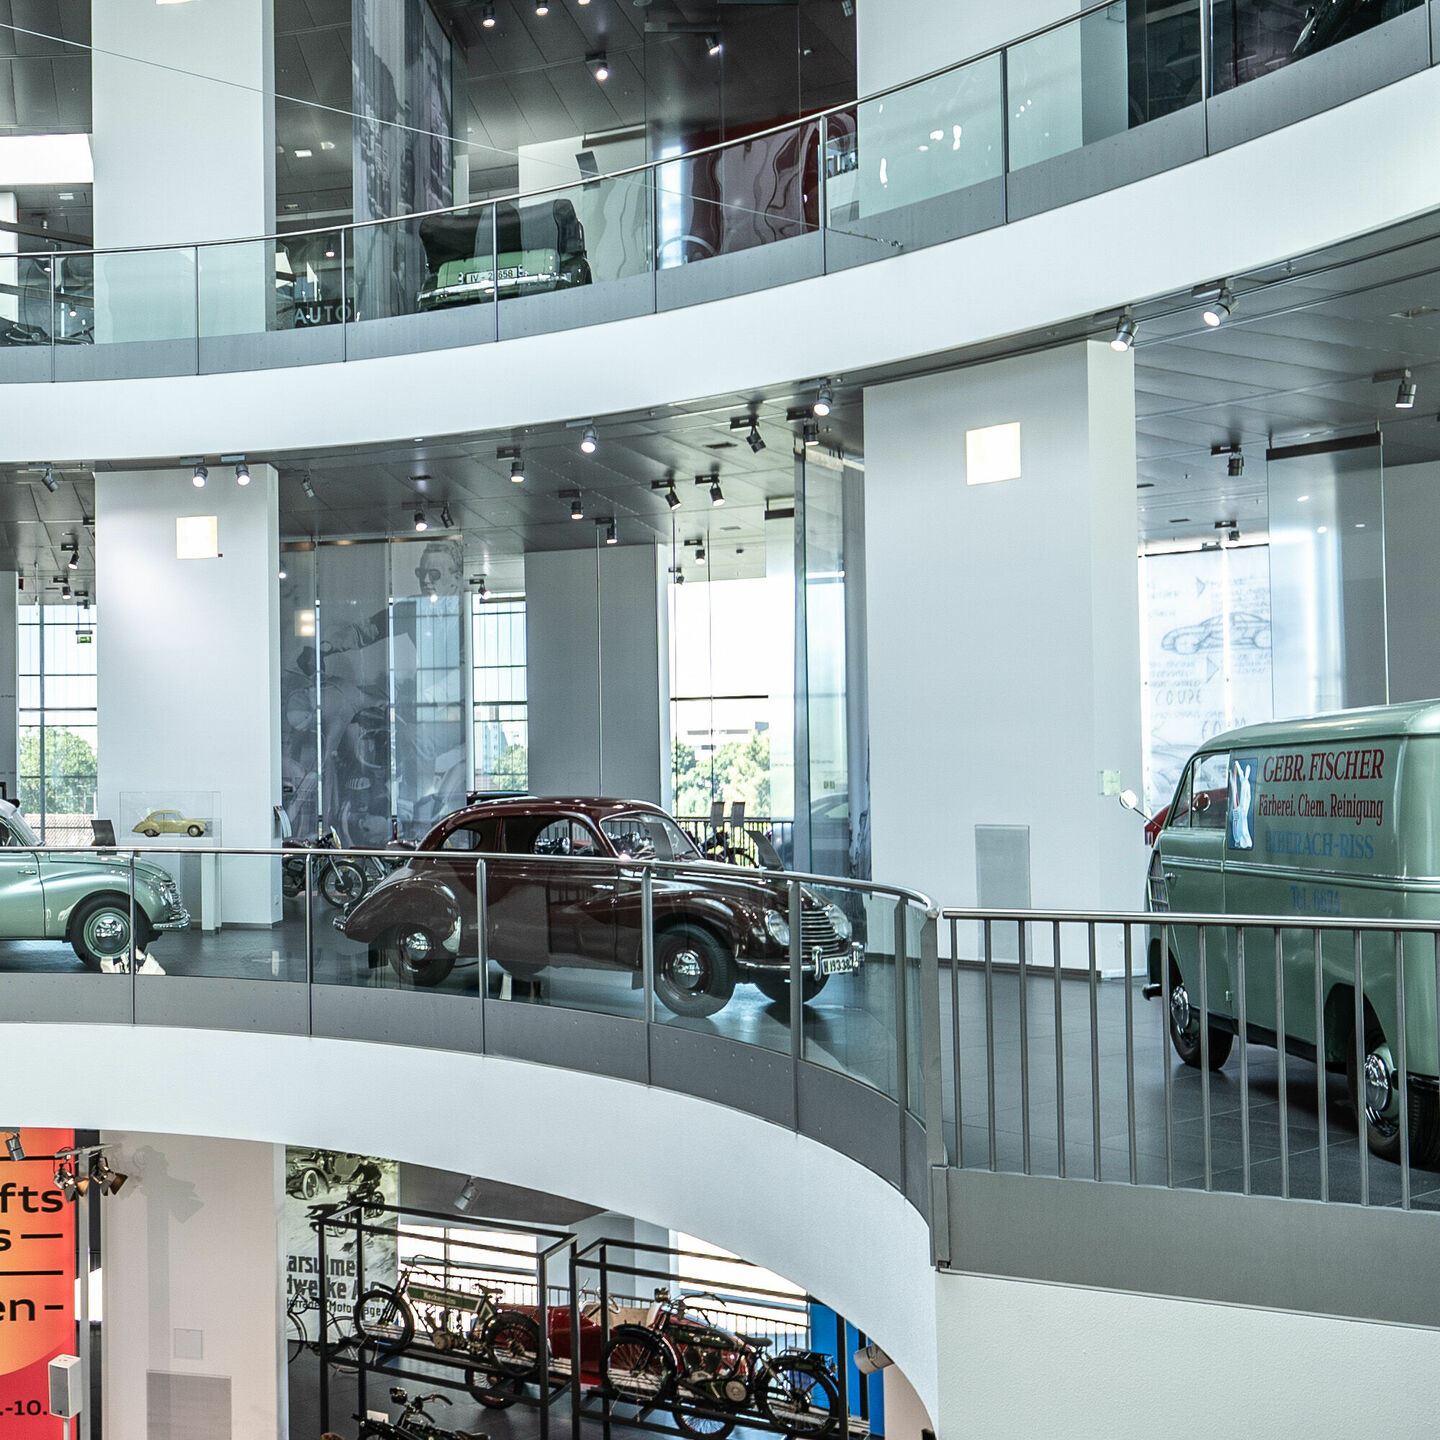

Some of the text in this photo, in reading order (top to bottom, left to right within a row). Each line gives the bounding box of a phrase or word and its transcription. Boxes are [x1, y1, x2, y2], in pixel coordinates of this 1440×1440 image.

[295, 304, 352, 325] AUTO
[1263, 749, 1385, 783] GEBR. FISCHER
[1258, 793, 1384, 827] Färberei. Chem. Reinigung
